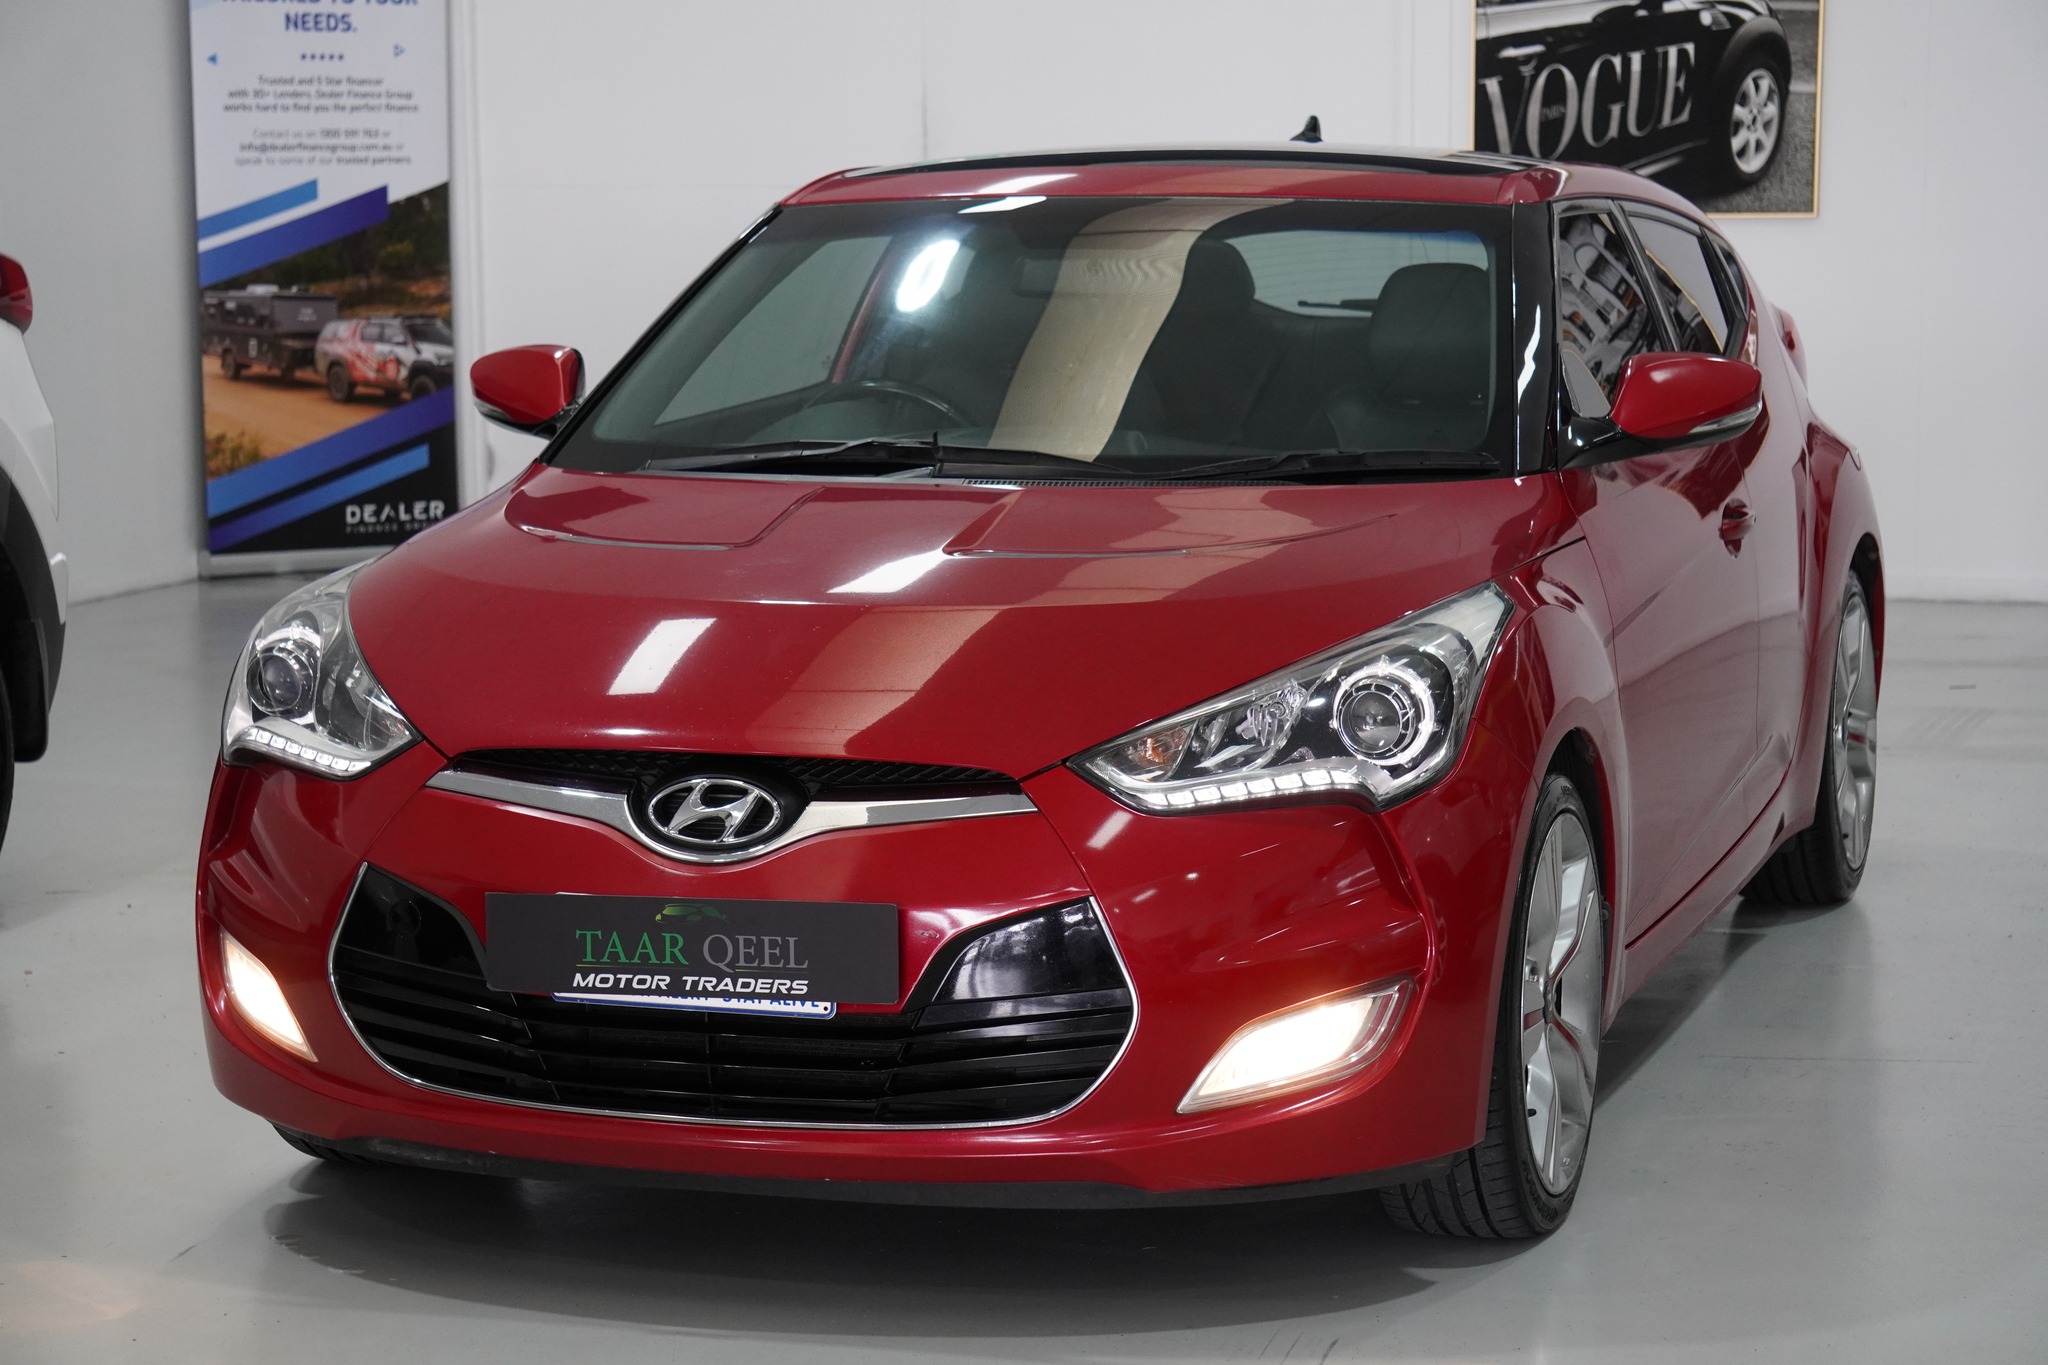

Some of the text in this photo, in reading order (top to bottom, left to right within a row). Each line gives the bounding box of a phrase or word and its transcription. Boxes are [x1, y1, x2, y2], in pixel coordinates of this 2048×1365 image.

[284, 13, 358, 32] NEEDS.
[1478, 41, 1696, 161] VOGUE
[345, 499, 446, 525] DEALER
[575, 929, 809, 974] TAAR QEEL
[572, 972, 809, 995] MOTOR TRADERS
